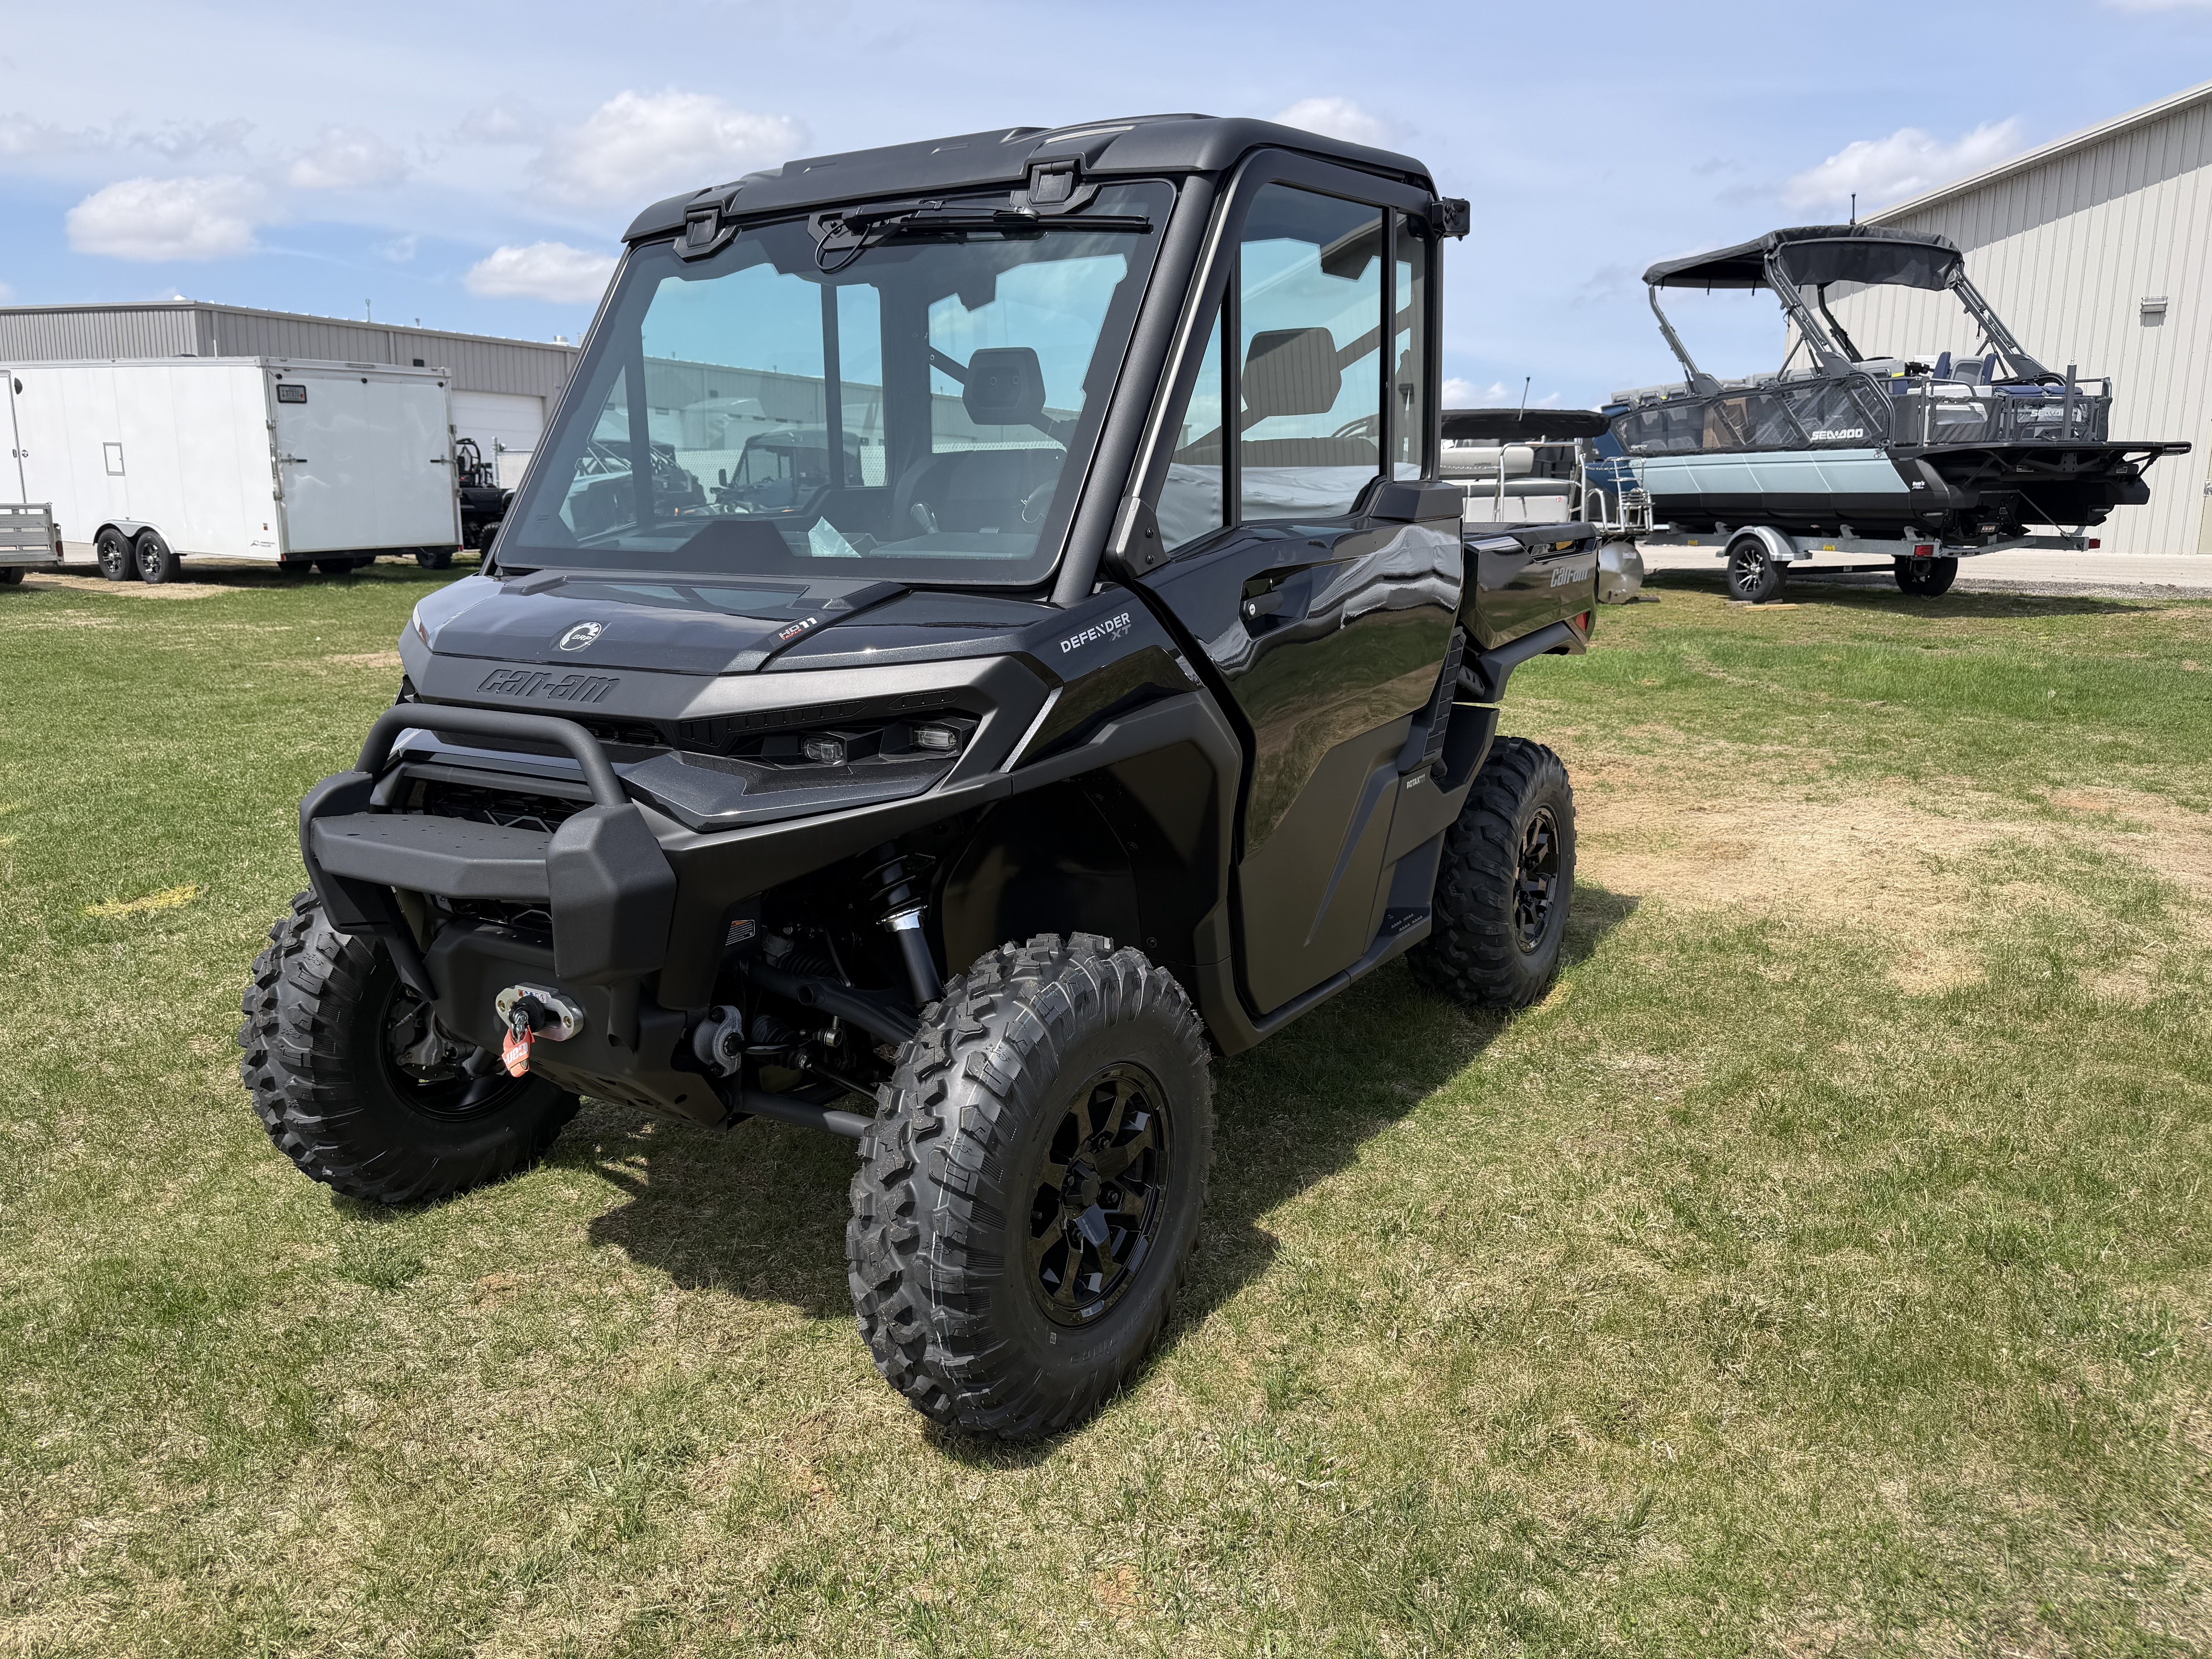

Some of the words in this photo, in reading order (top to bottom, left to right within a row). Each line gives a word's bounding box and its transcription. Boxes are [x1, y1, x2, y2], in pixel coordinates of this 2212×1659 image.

[1060, 612, 1130, 653] DEFENDER
[1109, 624, 1131, 642] XT
[1407, 777, 1420, 789] ROTAX
